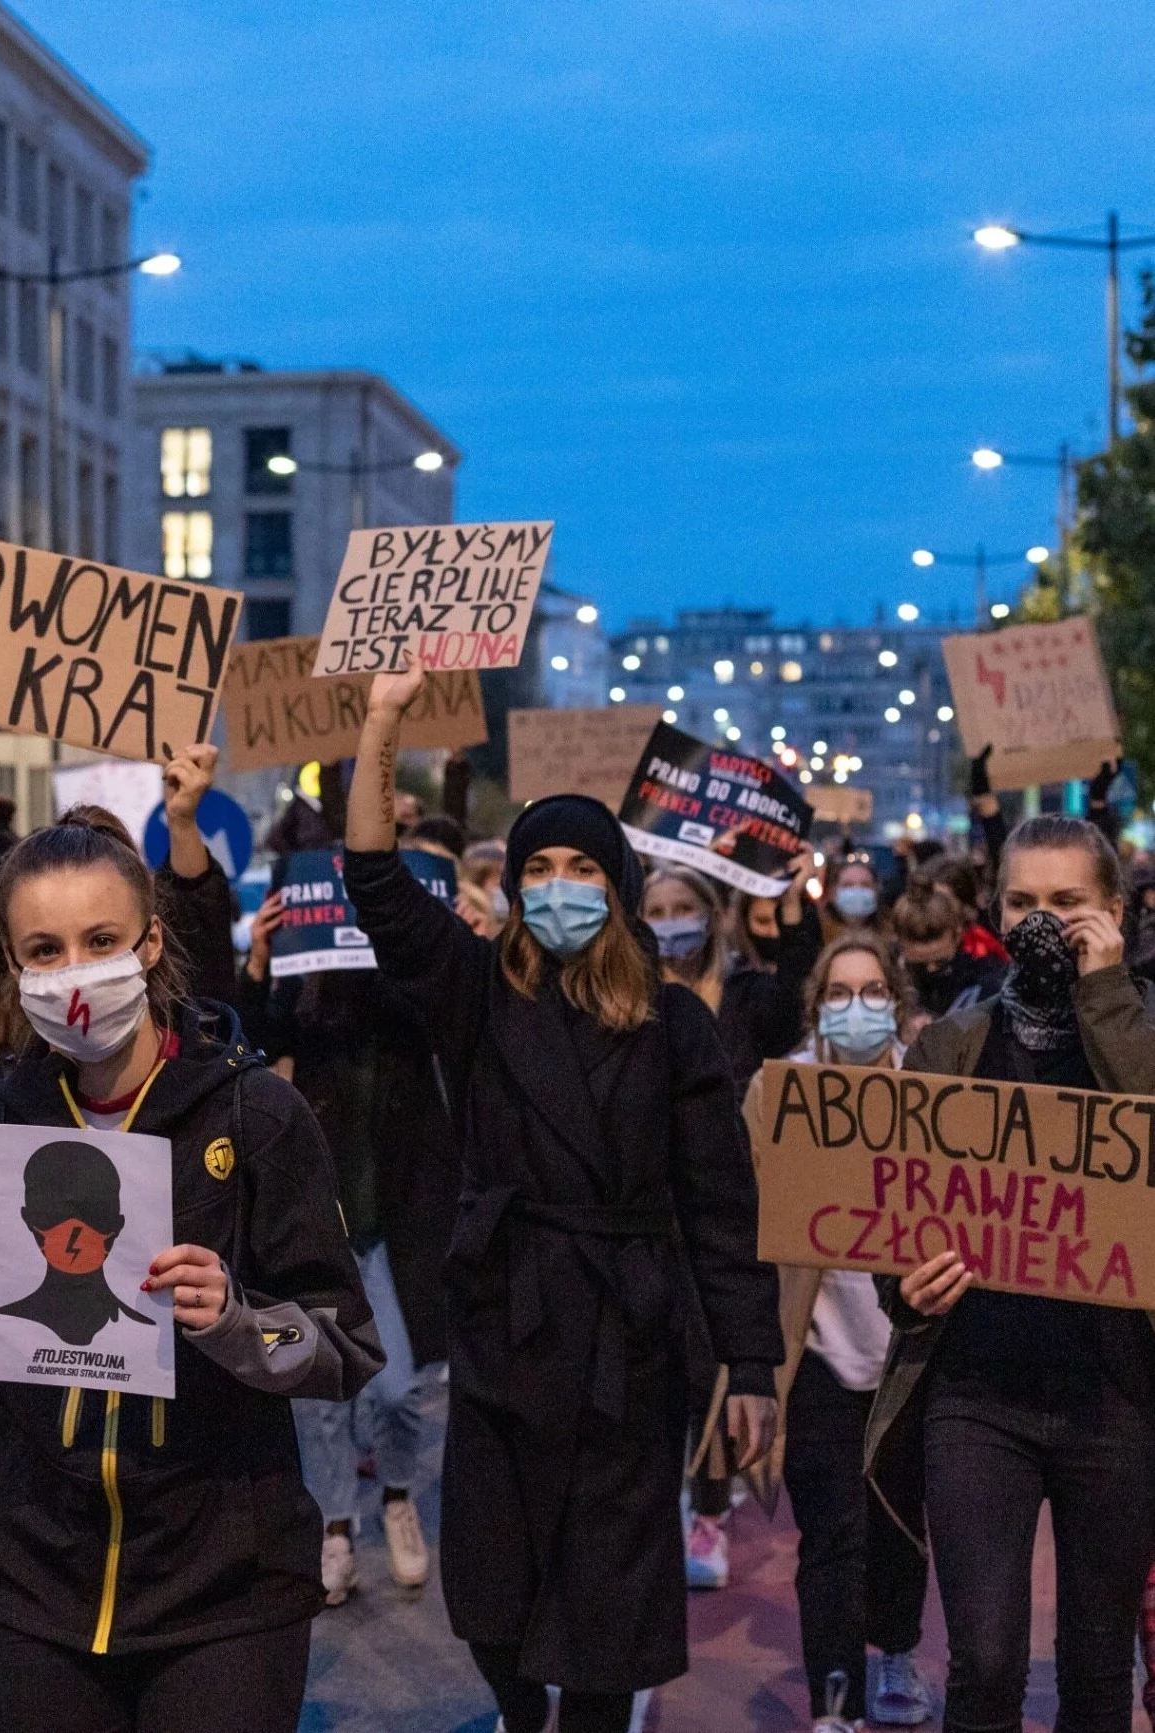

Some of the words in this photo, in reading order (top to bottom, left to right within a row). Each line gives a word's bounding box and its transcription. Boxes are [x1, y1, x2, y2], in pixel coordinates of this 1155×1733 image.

[369, 524, 554, 569] BYŁYŚMY
[339, 565, 537, 605] CIERPLIWE
[347, 603, 453, 637] TERAZ
[470, 603, 517, 634] TO
[324, 634, 411, 674] JEST
[418, 631, 520, 669] WOJNA
[8, 646, 215, 760] KRAJ
[771, 1067, 1037, 1166] ABORCJA
[1048, 1091, 1155, 1188] JEST
[872, 1156, 1086, 1237] PRAWEM
[808, 1205, 1137, 1298] CZŁOWIEKA
[26, 1364, 79, 1377] OGÓLNOPOLSKI
[80, 1368, 107, 1380] STRAJK
[106, 1370, 131, 1383] KOBIET
[31, 1348, 125, 1370] #TOJESTWOJNA
